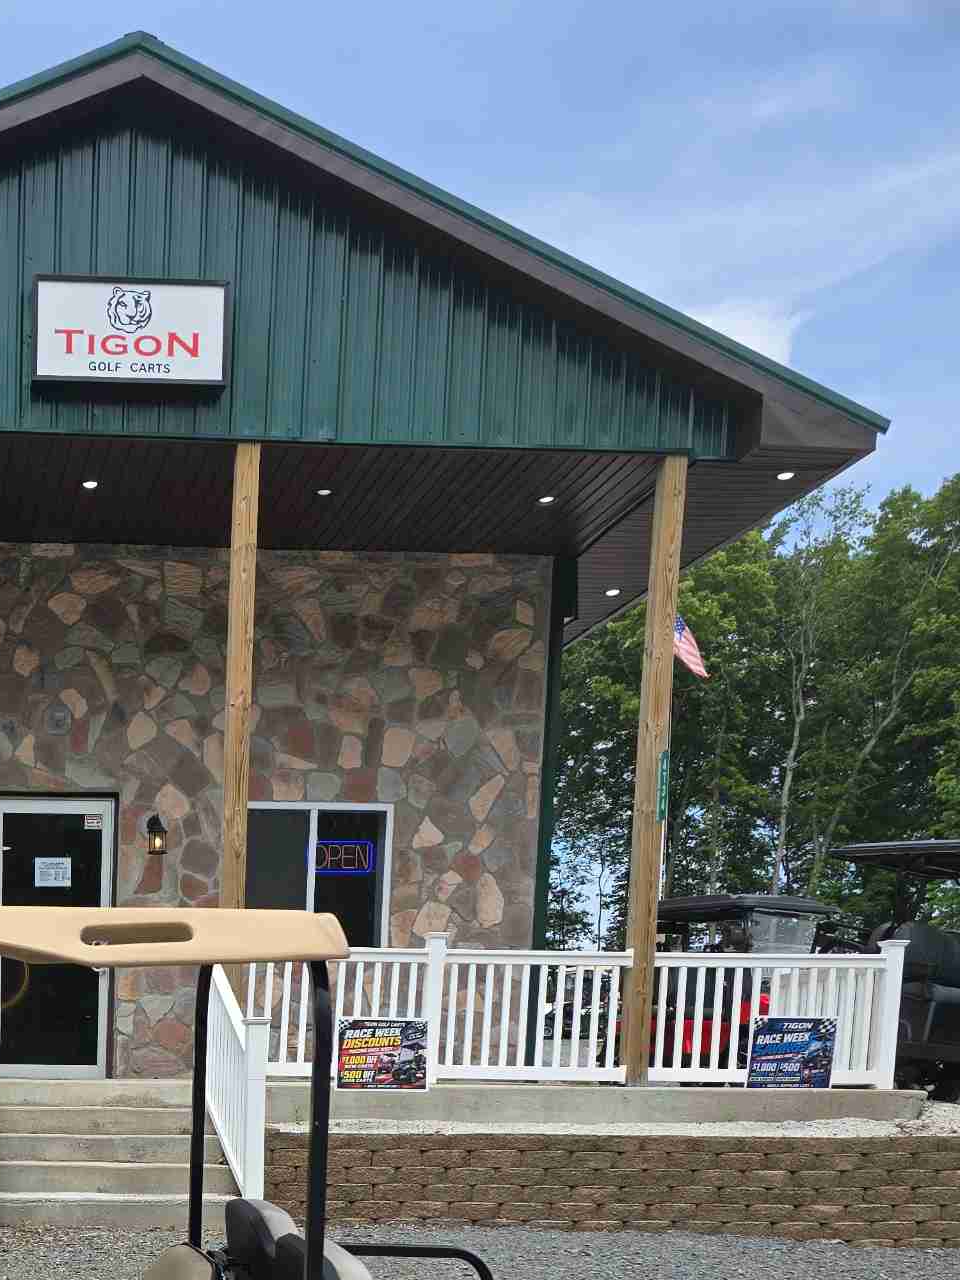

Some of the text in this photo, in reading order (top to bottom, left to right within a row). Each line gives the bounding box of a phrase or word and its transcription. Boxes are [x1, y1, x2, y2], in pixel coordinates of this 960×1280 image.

[54, 328, 200, 358] TIGON
[88, 361, 171, 374] GOLF CARTS
[315, 844, 369, 869] OPEN
[783, 1022, 814, 1030] TIGON
[344, 1029, 375, 1039] RACE
[374, 1028, 402, 1038] WEEK
[756, 1032, 810, 1045] RACE WEEK
[342, 1037, 402, 1049] DISCOUNTS
